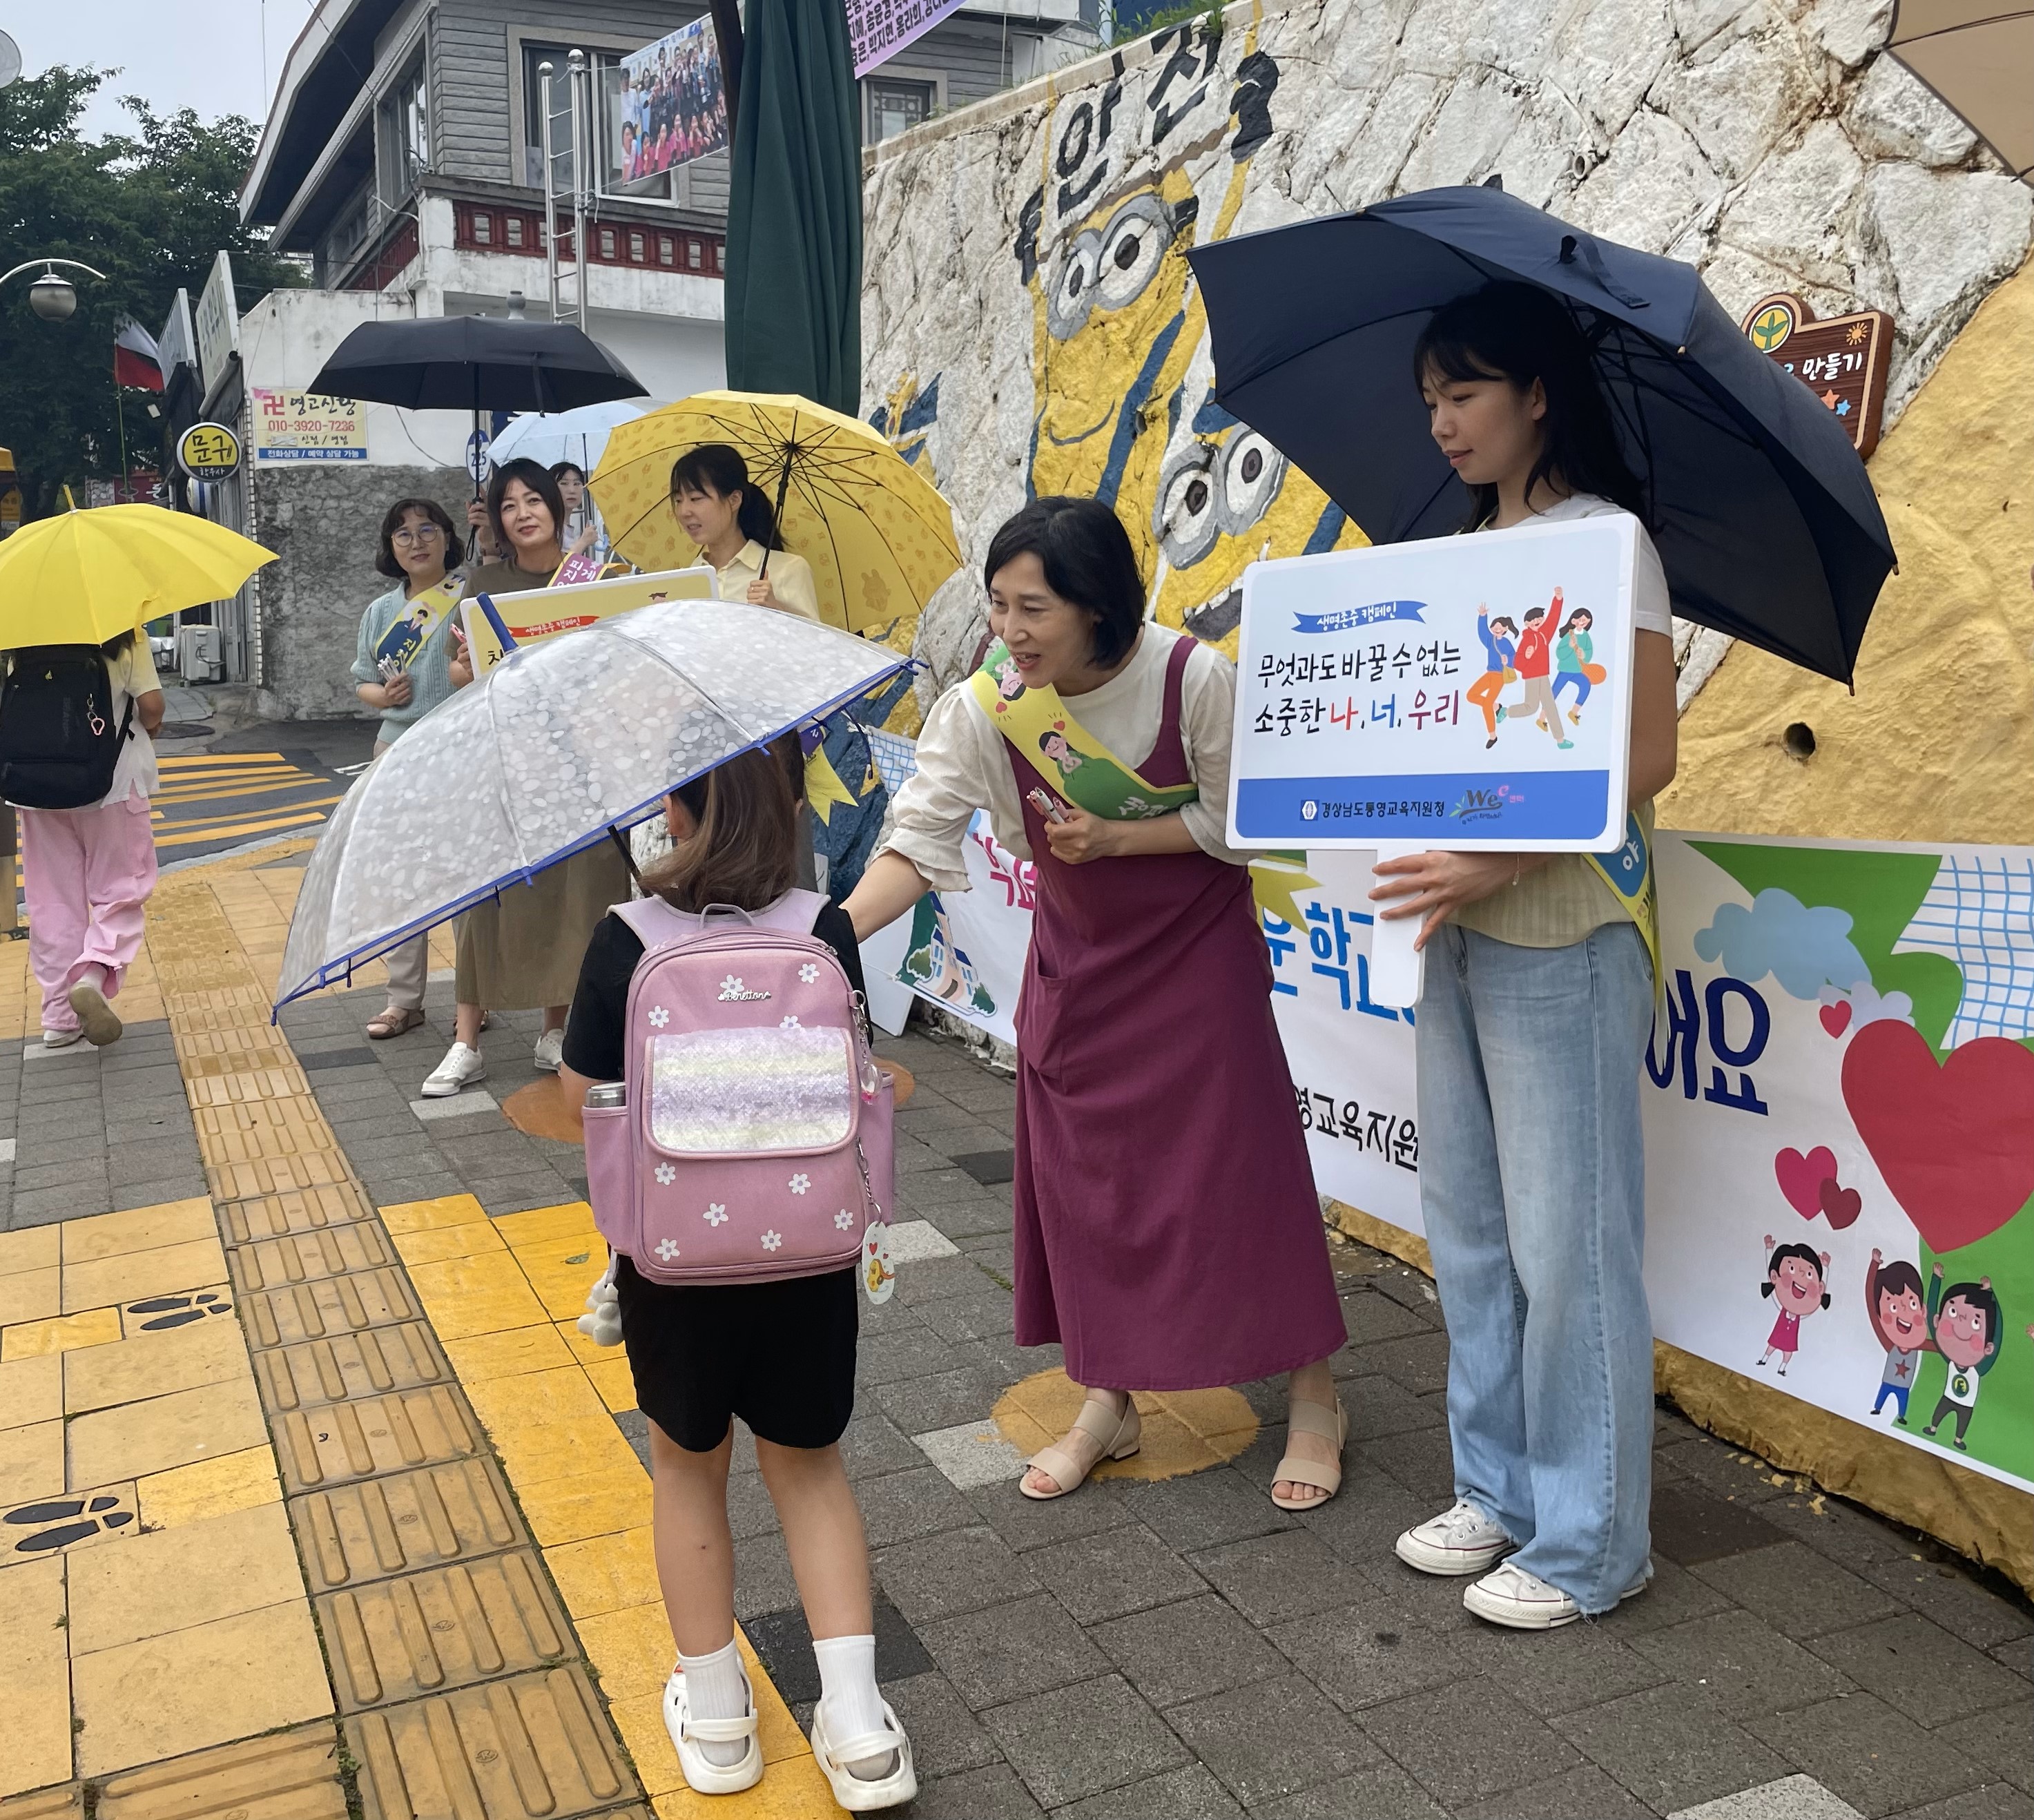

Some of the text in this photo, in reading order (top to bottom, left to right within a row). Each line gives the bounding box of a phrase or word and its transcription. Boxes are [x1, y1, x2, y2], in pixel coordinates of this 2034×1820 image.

[1802, 351, 1863, 380] 만들기
[268, 420, 355, 432] 010-3920-7236
[193, 435, 229, 463] 문구
[267, 449, 299, 458] 전화상담
[326, 449, 342, 458] 상담
[1317, 601, 1397, 631] 생명존중 캠페인
[1258, 640, 1461, 688] 무엇과도 바꿀 수 없는
[1254, 697, 1326, 737] 소중한
[1408, 689, 1459, 730] 우리
